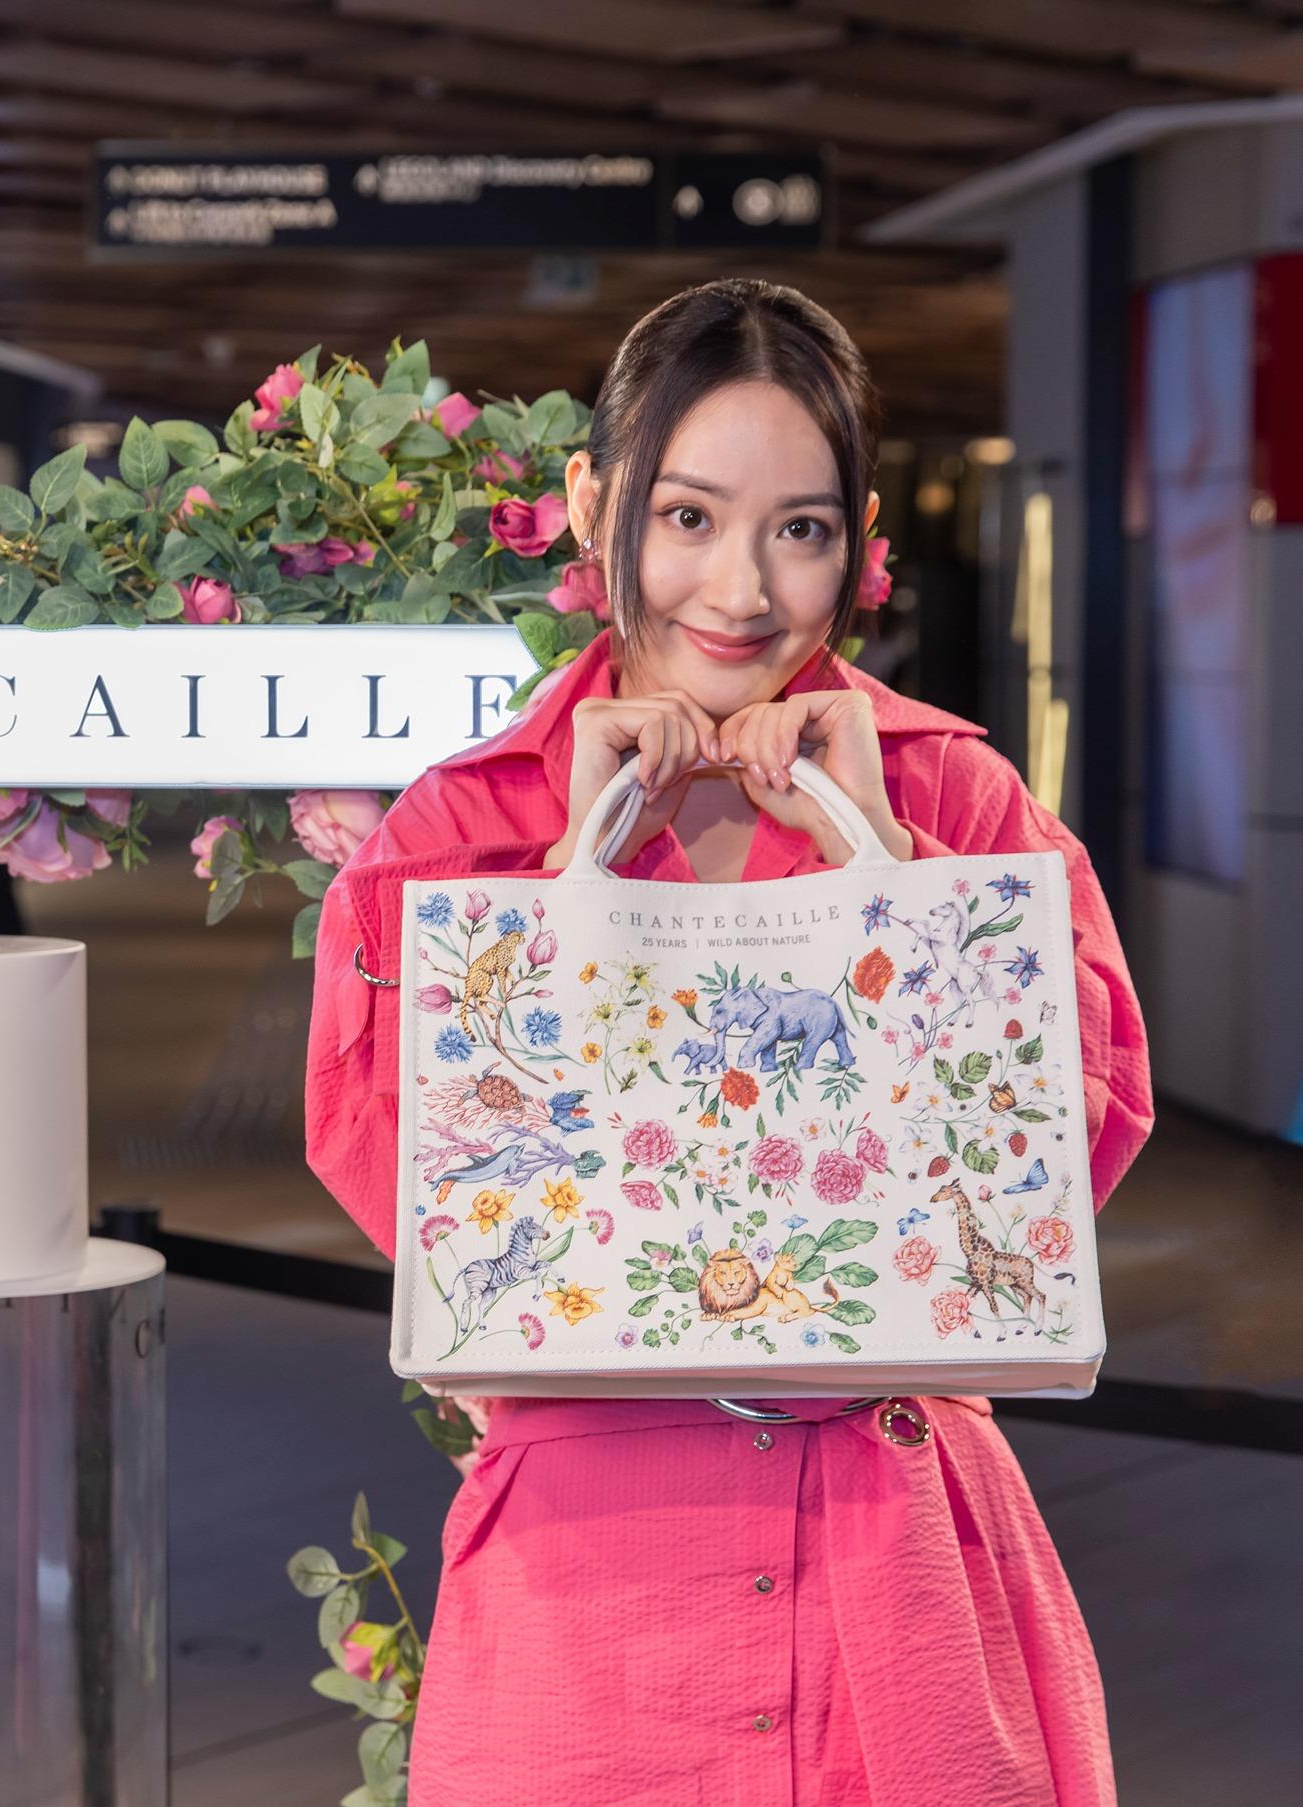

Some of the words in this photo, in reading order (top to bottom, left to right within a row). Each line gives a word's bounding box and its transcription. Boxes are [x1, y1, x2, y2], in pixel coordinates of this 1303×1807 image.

[608, 904, 840, 930] CHANTECAILLE
[641, 936, 654, 947] 25
[655, 937, 687, 949] YEARS
[707, 937, 733, 948] WILD
[735, 936, 769, 947] ABOUT
[772, 934, 811, 946] NATURE
